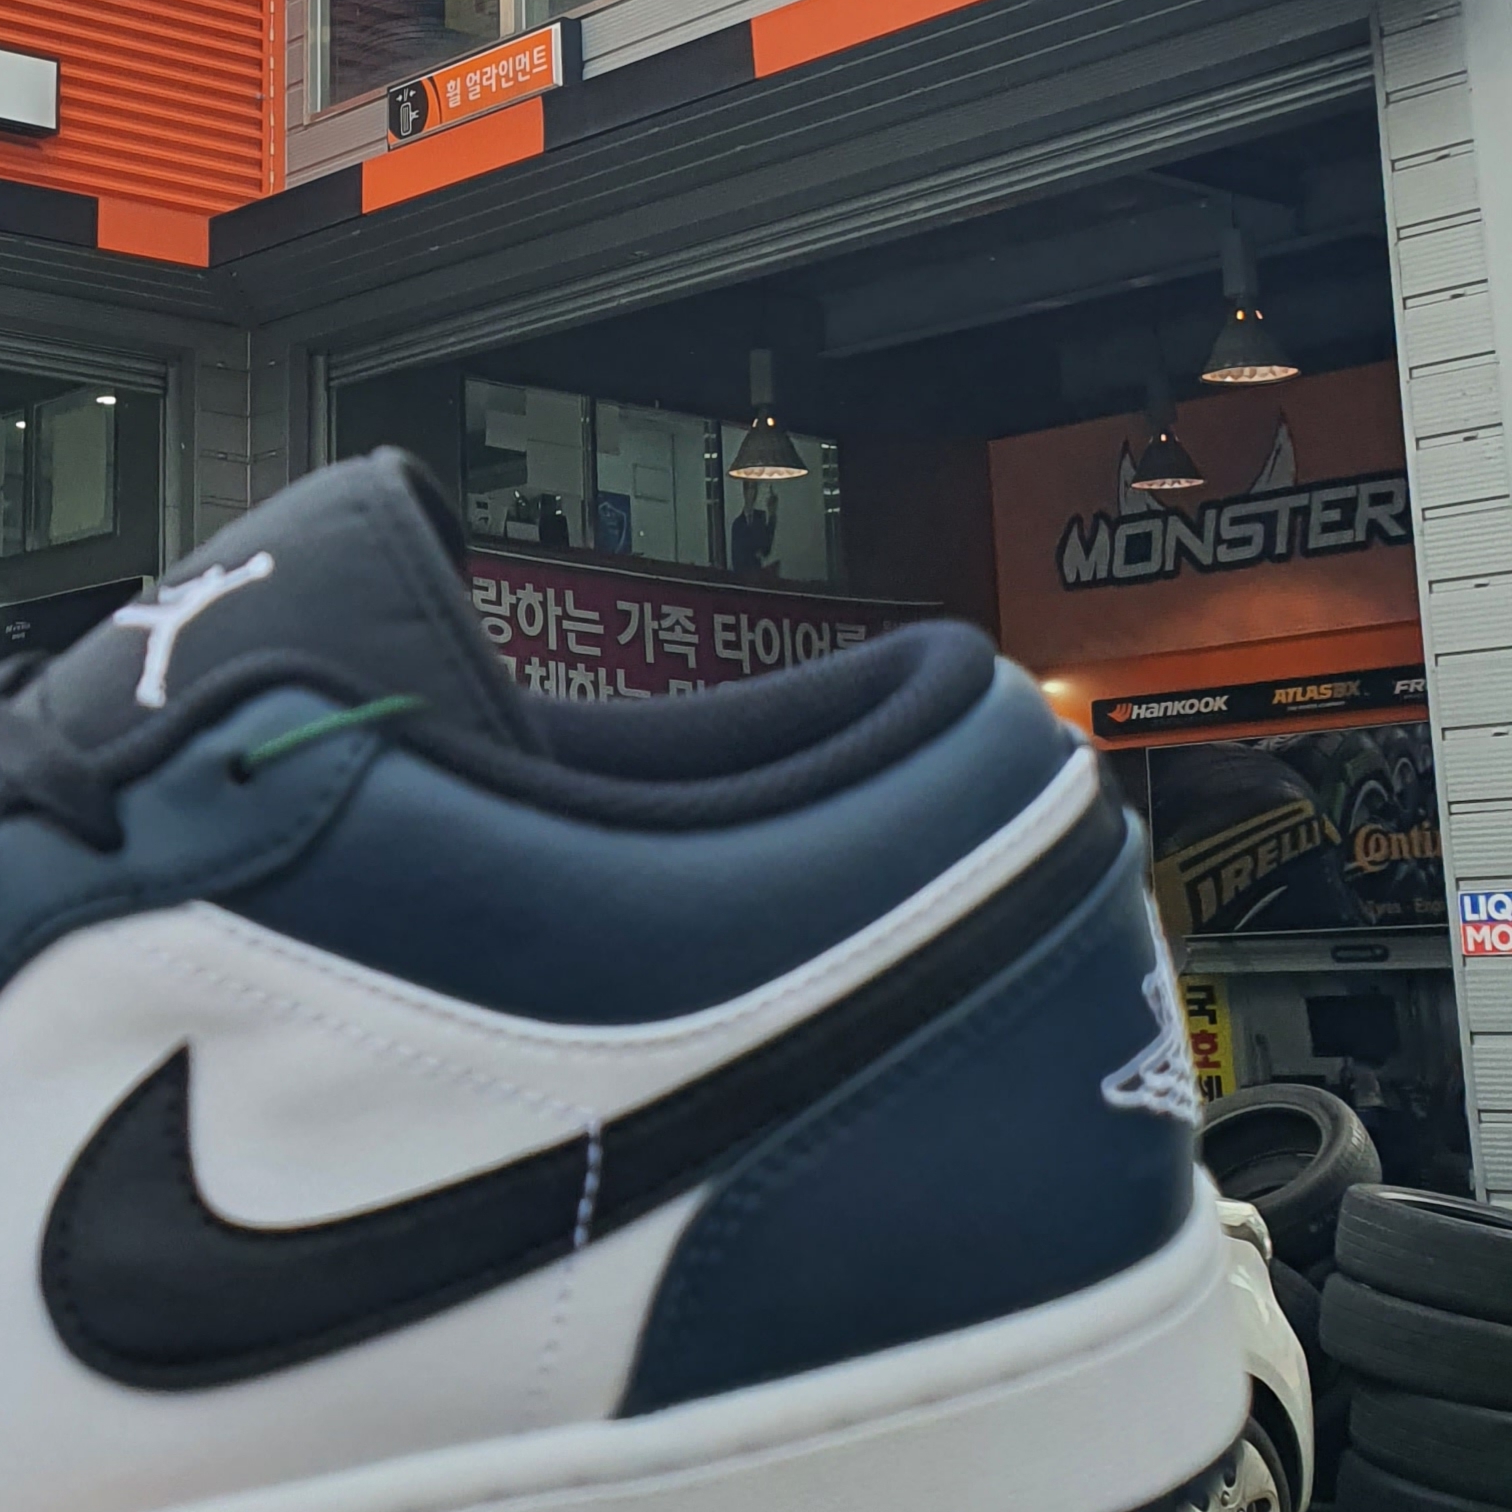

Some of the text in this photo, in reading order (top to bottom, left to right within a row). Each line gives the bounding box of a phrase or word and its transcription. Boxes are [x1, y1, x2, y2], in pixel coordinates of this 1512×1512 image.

[465, 44, 549, 102] 얼라인먼트
[1061, 477, 1410, 585] MONSTER
[616, 597, 699, 670] 가족
